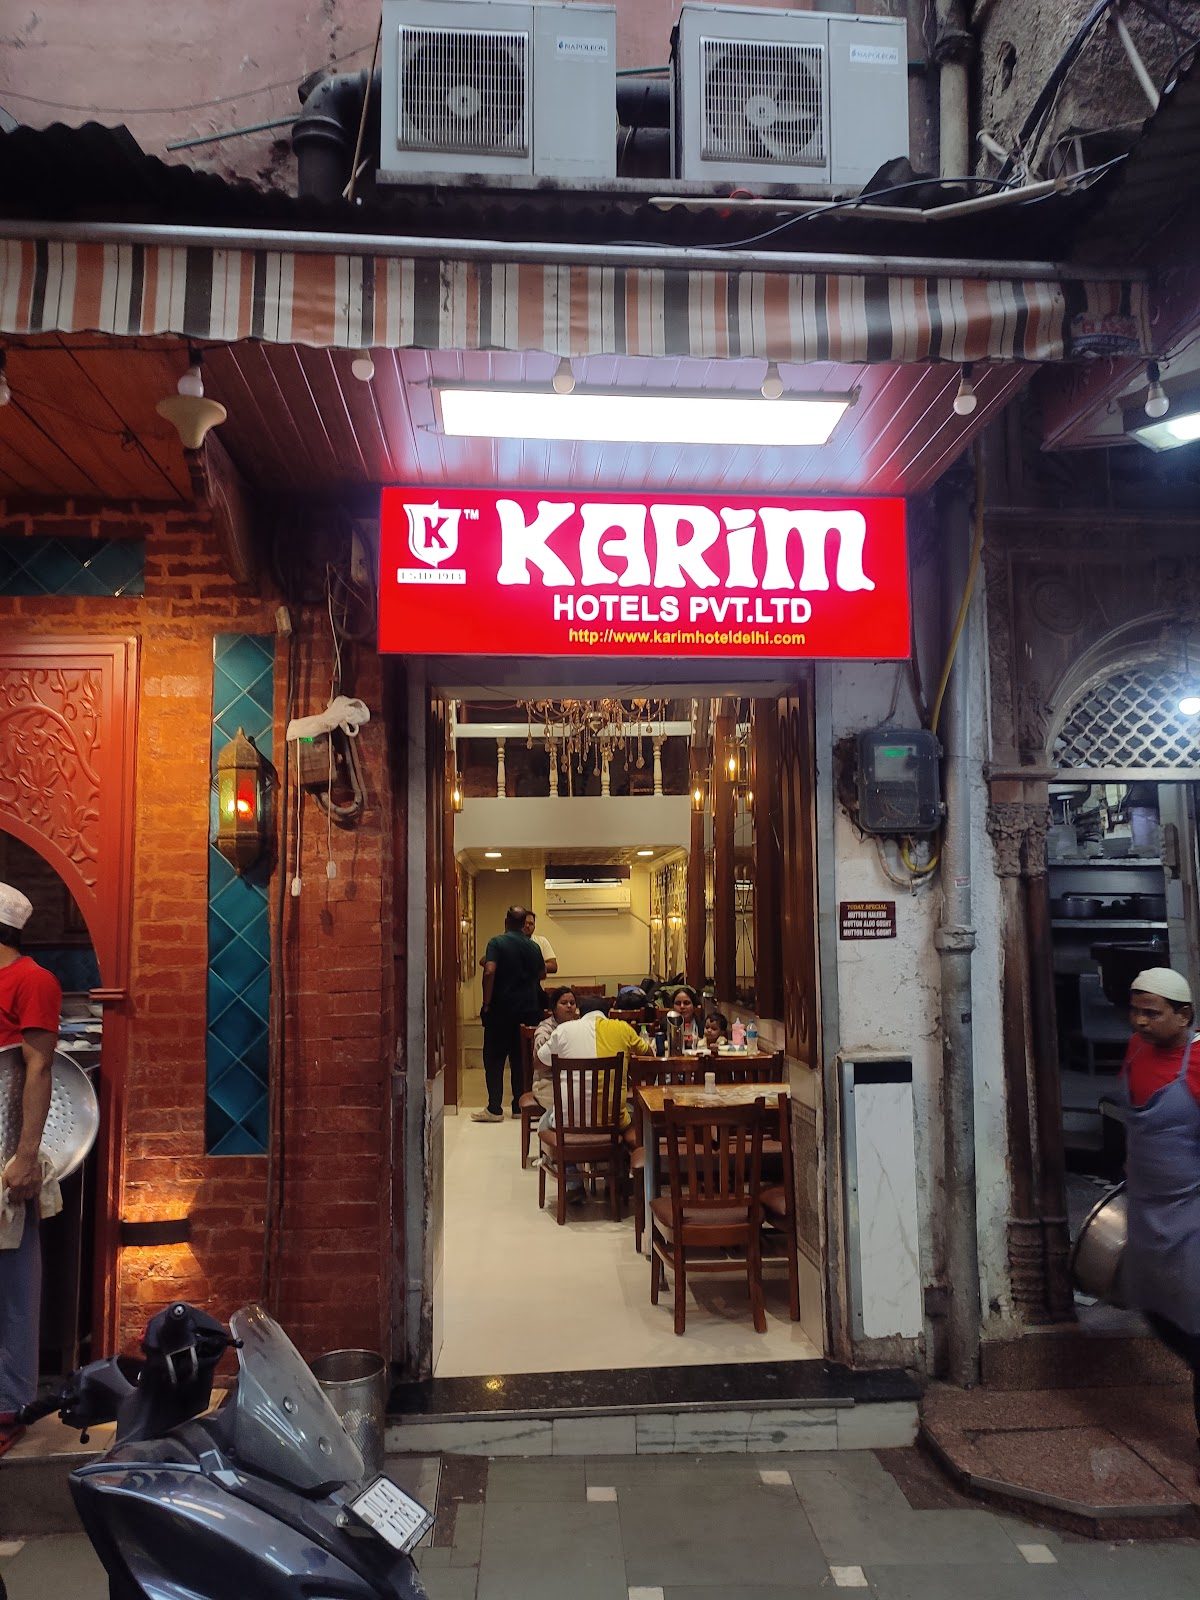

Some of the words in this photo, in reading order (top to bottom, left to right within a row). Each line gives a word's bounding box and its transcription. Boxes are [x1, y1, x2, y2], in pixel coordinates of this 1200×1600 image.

[463, 509, 479, 520] TM
[423, 516, 449, 548] K
[553, 594, 680, 623] HOTELS
[689, 596, 812, 624] PVT.LTD
[568, 628, 806, 645] http://www.karimhoteldelhi.com
